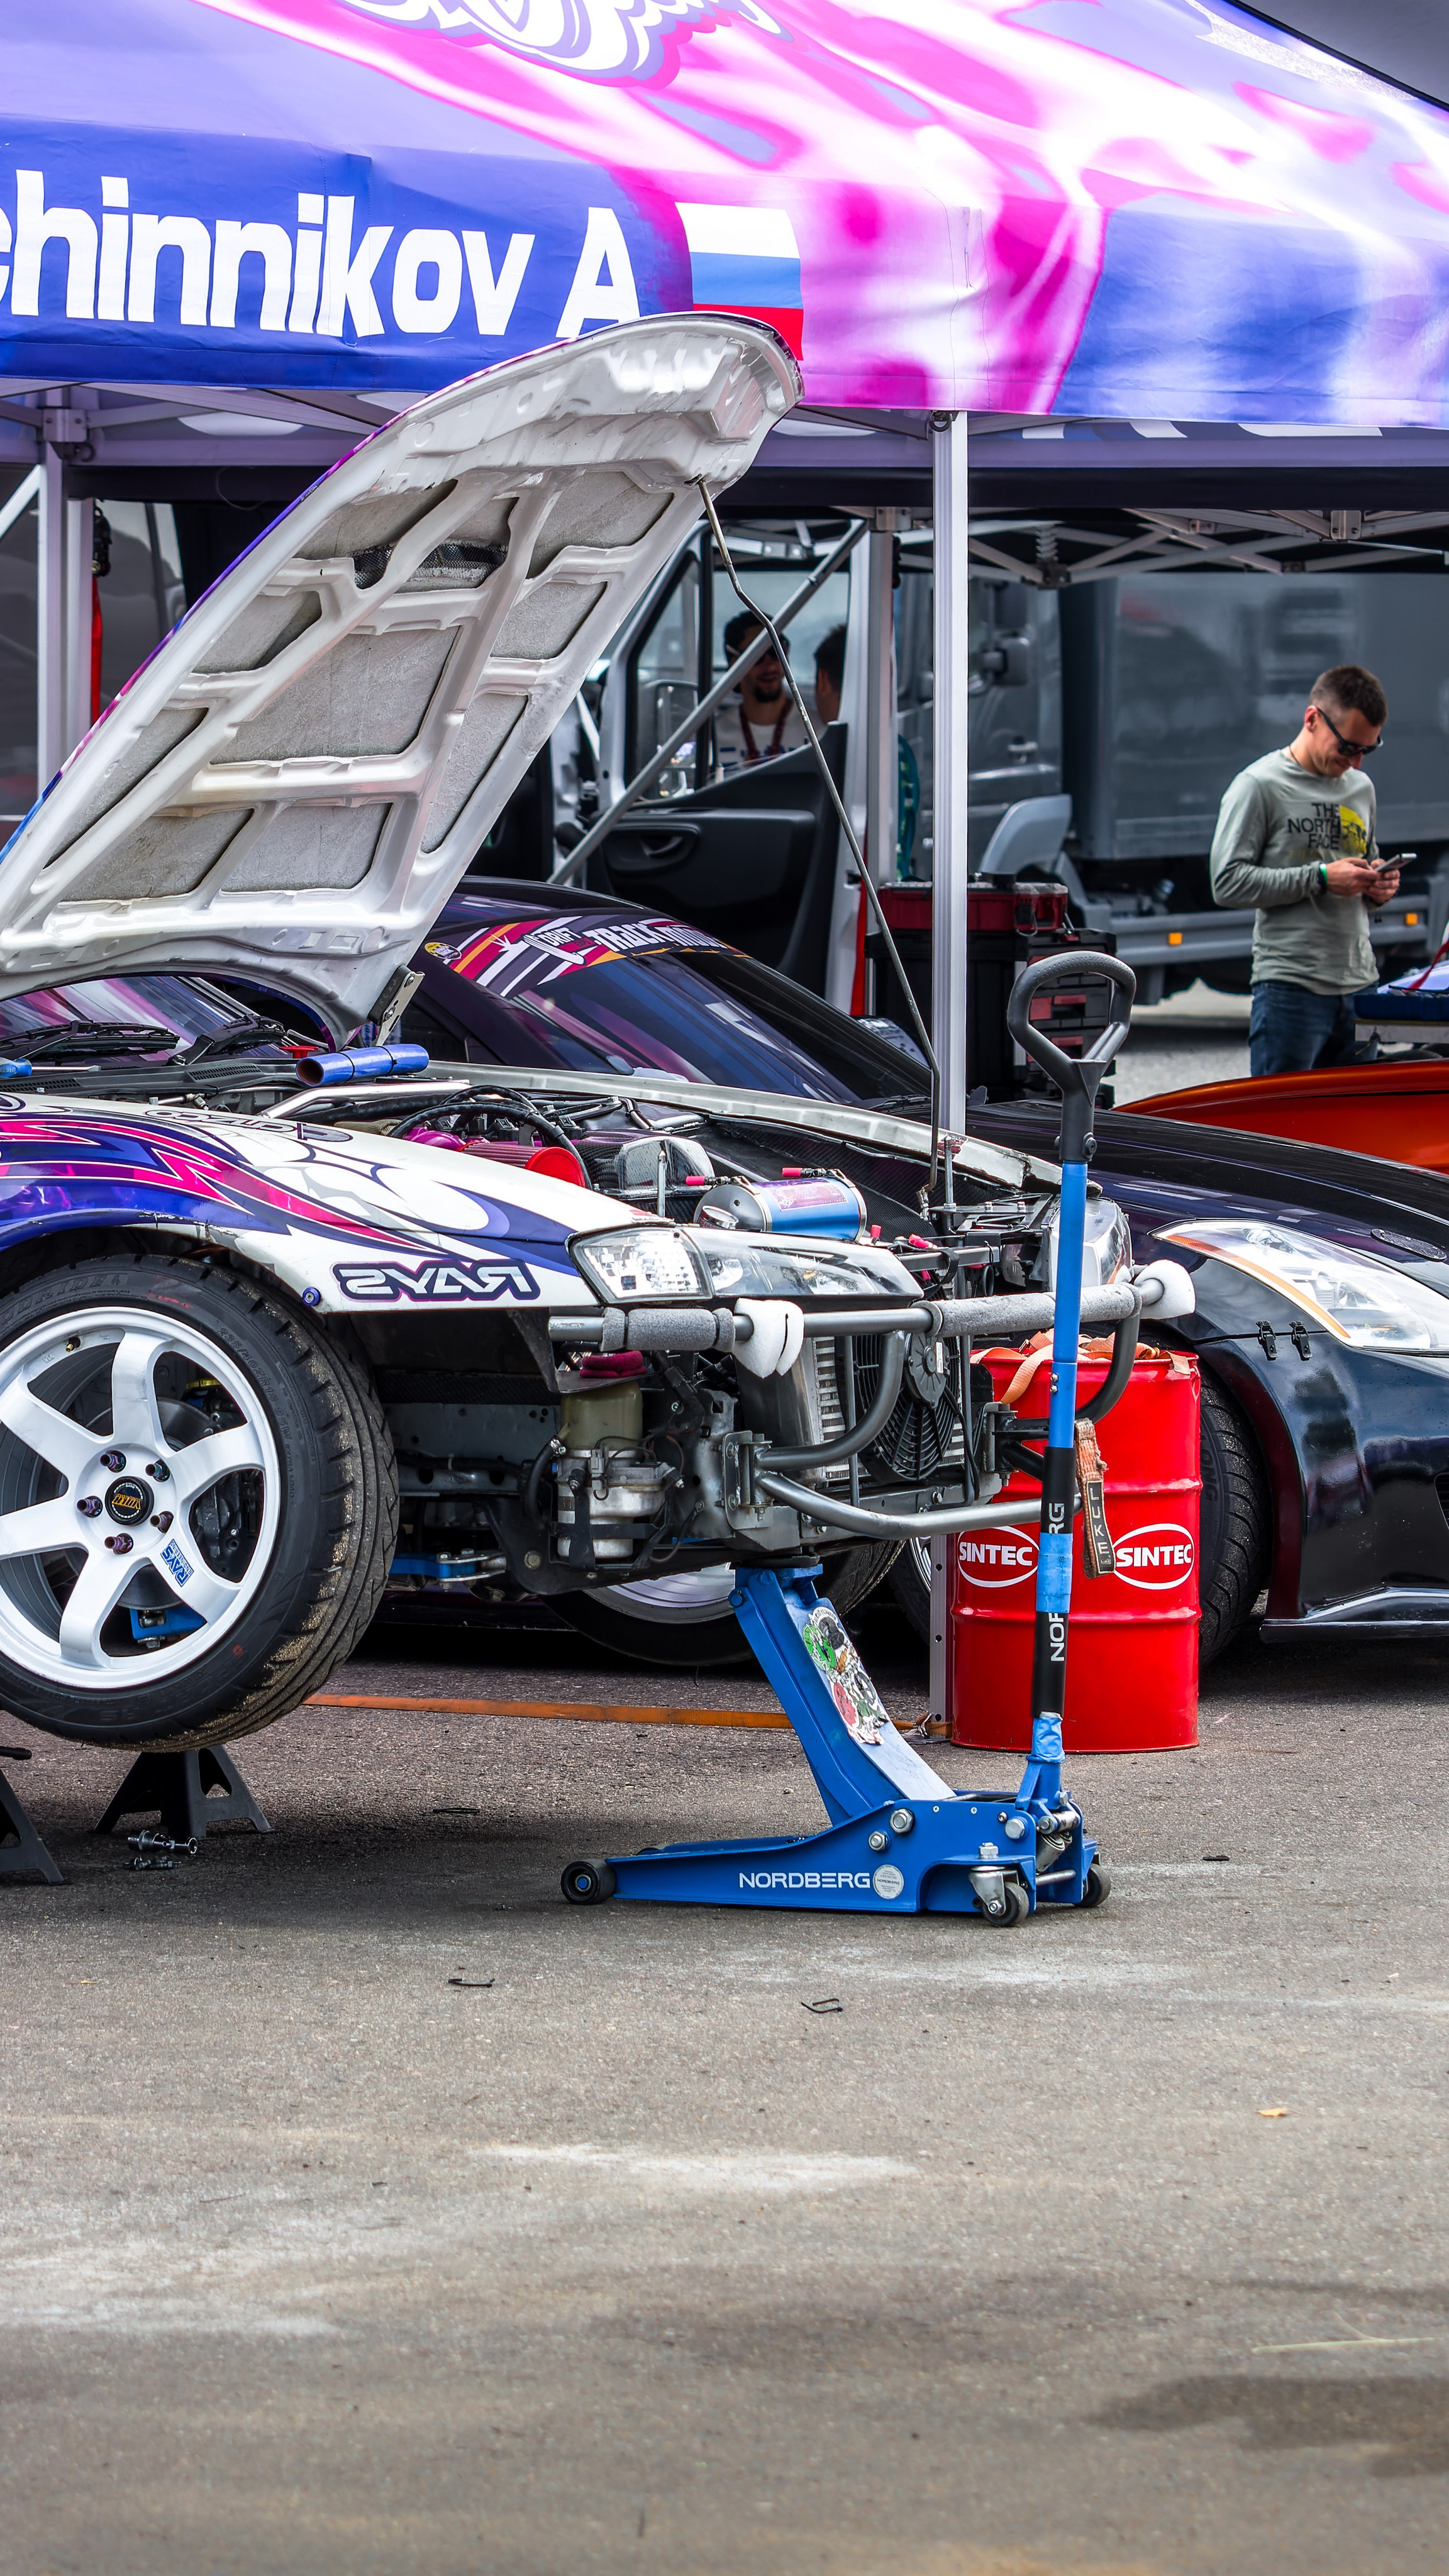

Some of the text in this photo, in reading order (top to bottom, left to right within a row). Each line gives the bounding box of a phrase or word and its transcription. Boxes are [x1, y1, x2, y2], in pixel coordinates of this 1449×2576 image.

[0, 170, 641, 338] hinnikov A
[1311, 802, 1340, 818] THE
[1287, 818, 1341, 835] NORTH
[1308, 833, 1340, 850] FACE
[537, 927, 582, 947] DRIFT
[582, 923, 675, 952] TRACK
[1089, 1488, 1109, 1555] LUKE
[162, 1546, 189, 1584] RAYS
[170, 1541, 192, 1575] ENGINEERING
[959, 1541, 1033, 1567] SINTEC
[1116, 1544, 1192, 1567] SINTEC
[739, 1872, 870, 1888] NORDBERG
